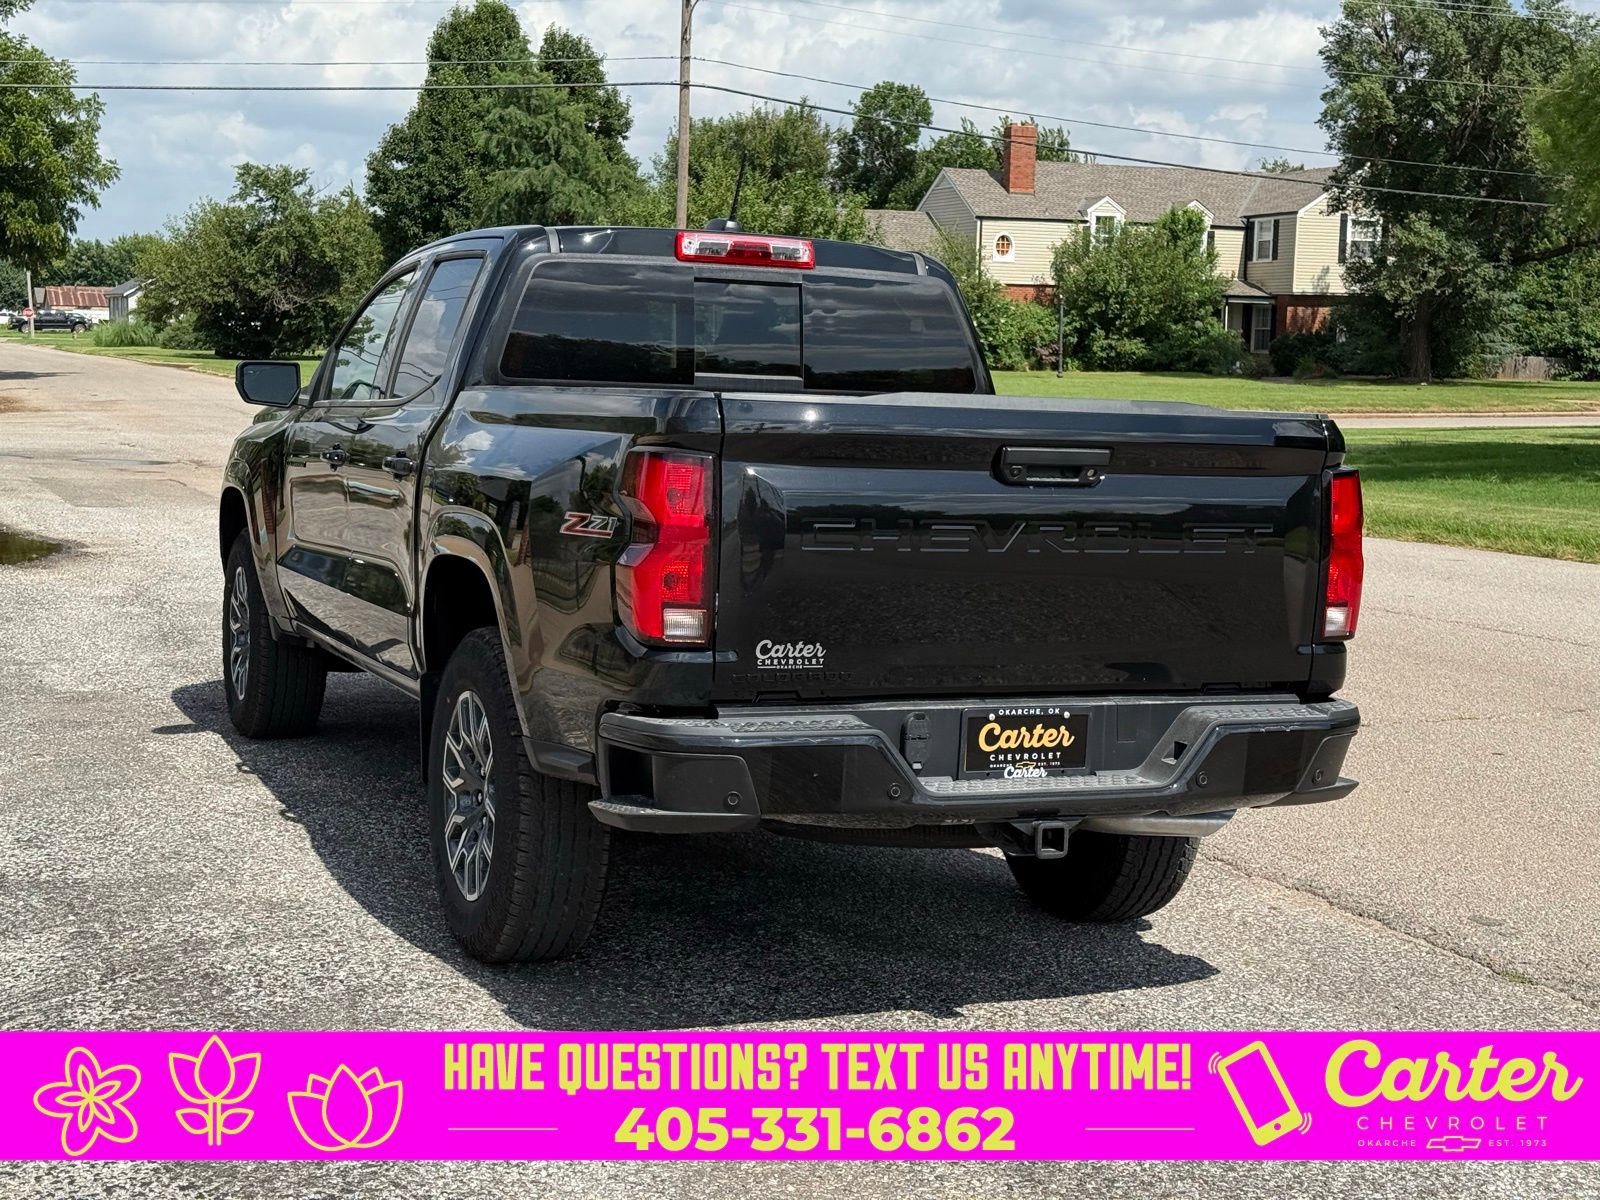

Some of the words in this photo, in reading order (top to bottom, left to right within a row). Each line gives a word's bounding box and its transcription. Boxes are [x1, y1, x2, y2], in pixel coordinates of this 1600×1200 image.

[560, 511, 618, 539] Z71
[800, 517, 1274, 554] CHEVROLET
[755, 639, 827, 660] Carter
[757, 658, 825, 666] CHEVROLET
[998, 708, 1044, 716] OKARCHE,
[1048, 707, 1060, 715] OK
[978, 722, 1075, 752] Carter
[989, 752, 1061, 762] CHEVROLET
[1003, 765, 1048, 779] Carter
